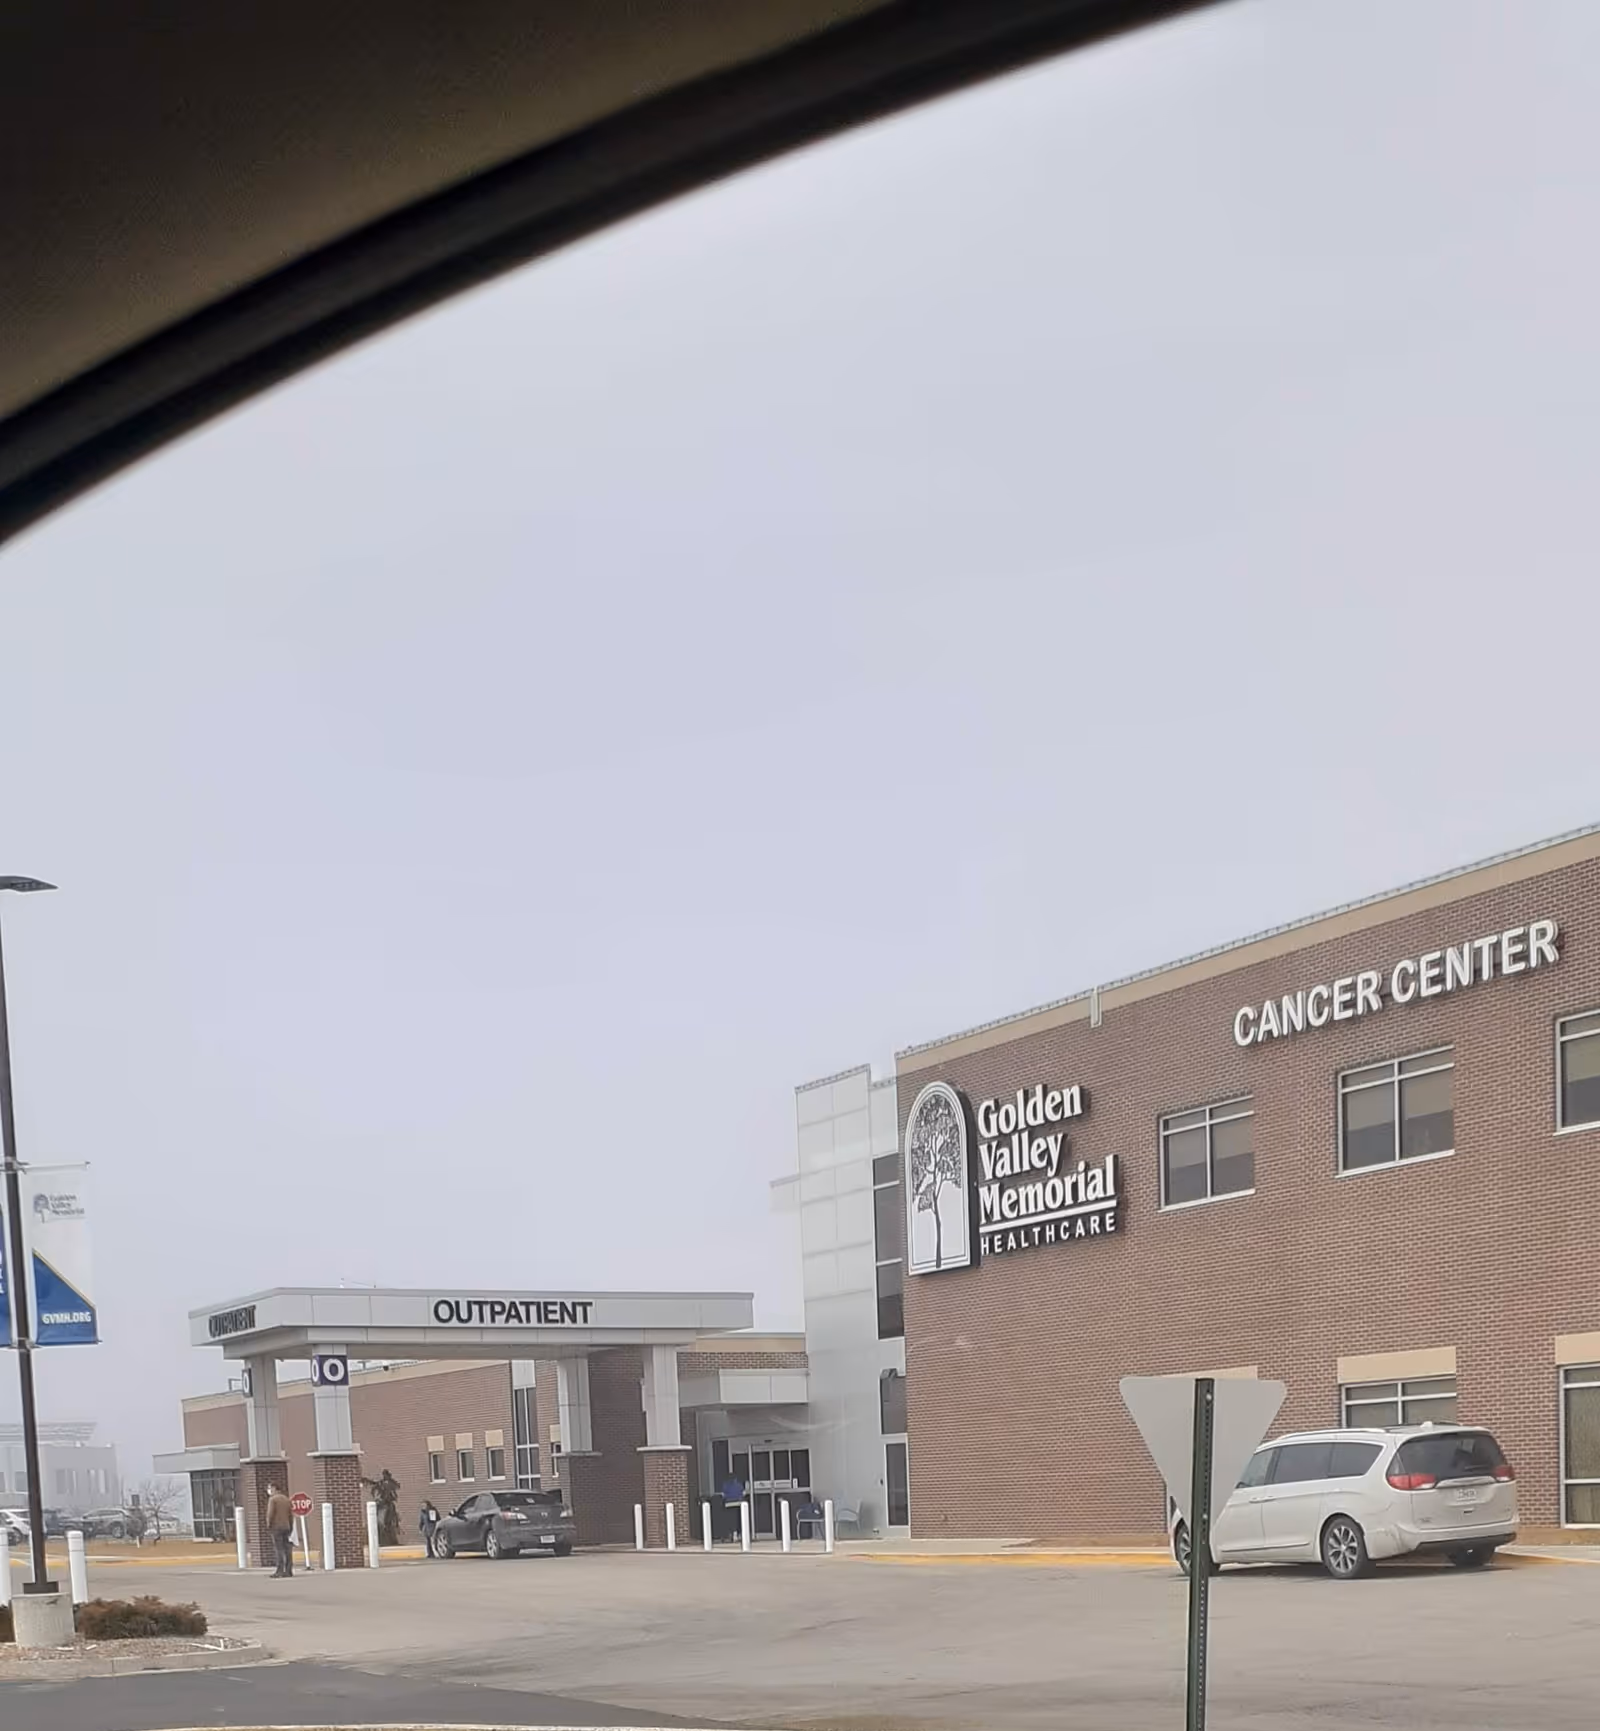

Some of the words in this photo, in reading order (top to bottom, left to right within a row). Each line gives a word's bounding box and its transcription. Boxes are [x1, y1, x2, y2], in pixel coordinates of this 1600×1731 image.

[1234, 970, 1382, 1046] CANCER
[1391, 919, 1558, 1003] CENTER
[978, 1084, 1083, 1138] Golden
[979, 1131, 1064, 1180] Valley
[979, 1154, 1116, 1225] Memorial
[981, 1211, 1116, 1256] HEALTHCARE
[42, 1311, 91, 1325] GVMH.ORG
[433, 1299, 593, 1324] OUTPATIENT
[291, 1499, 311, 1510] STOP
